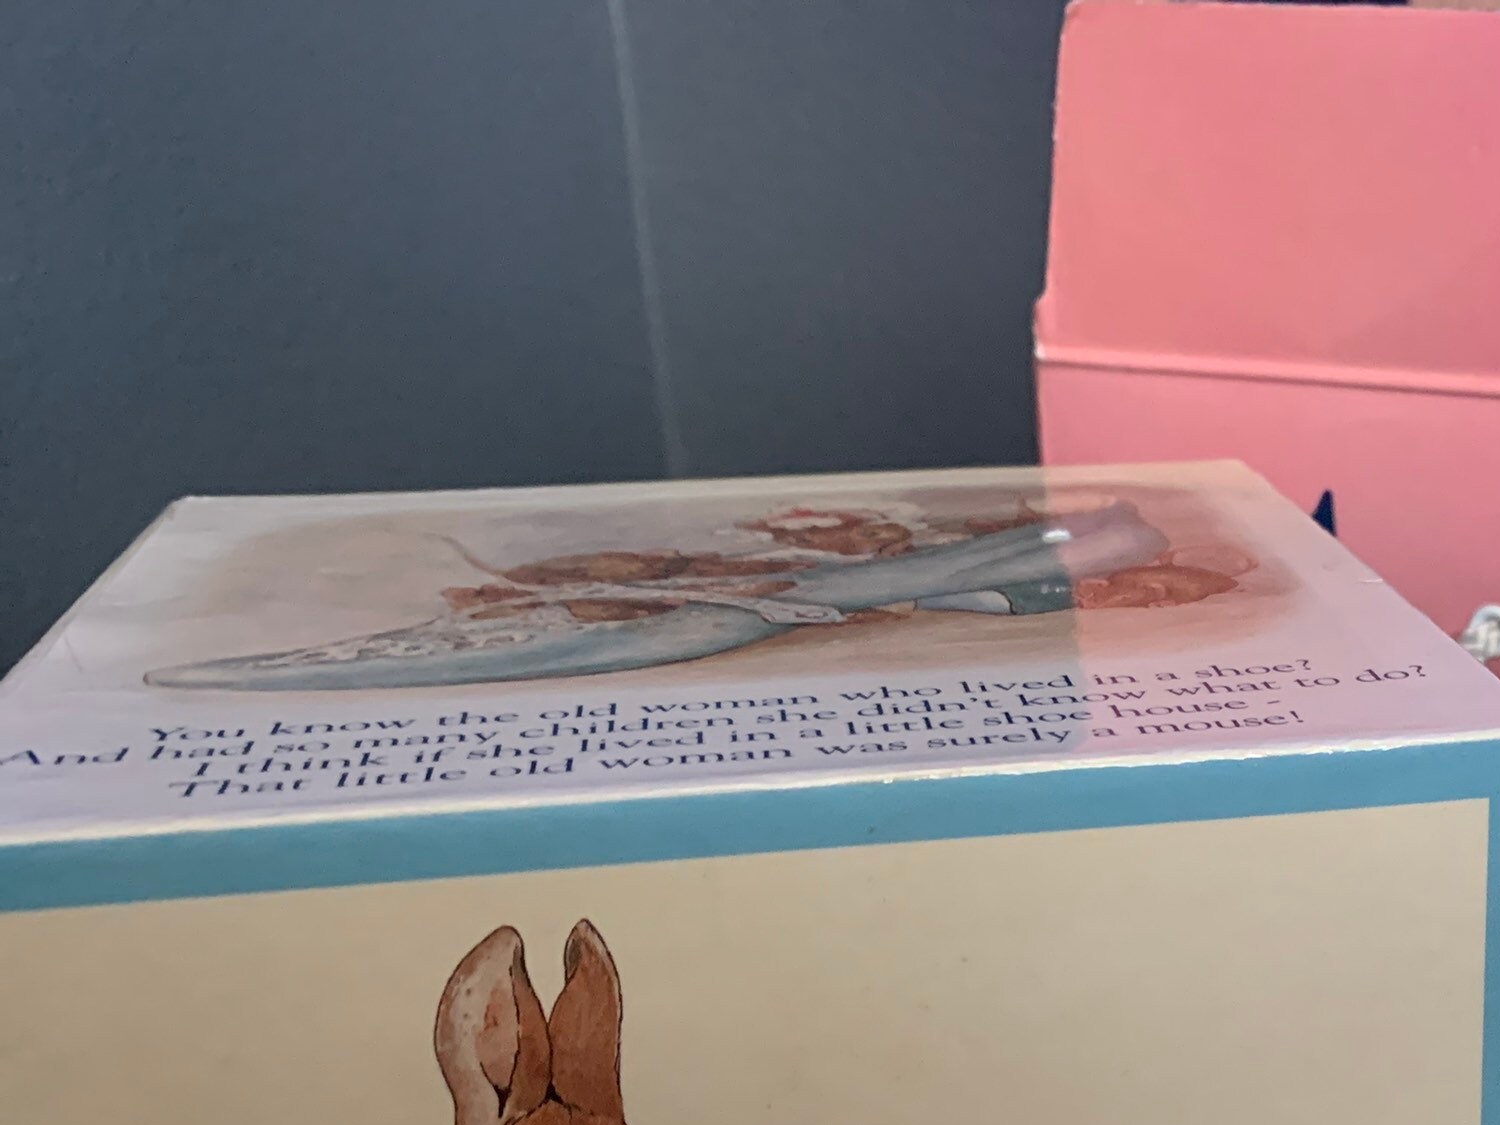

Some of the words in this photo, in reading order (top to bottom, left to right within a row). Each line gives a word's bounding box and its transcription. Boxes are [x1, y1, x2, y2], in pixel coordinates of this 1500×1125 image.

[0, 747, 129, 765] And
[150, 740, 254, 760] had
[273, 743, 330, 753] so
[353, 730, 502, 750] many
[519, 717, 735, 740] children
[757, 710, 839, 724] she
[857, 697, 1003, 717] didn't
[1019, 690, 1147, 708] know
[1166, 680, 1282, 698] what
[1294, 675, 1340, 688] to
[1355, 665, 1427, 684] do?
[150, 727, 244, 741] You
[269, 718, 416, 736] know
[439, 711, 519, 726] the
[540, 702, 616, 720] old
[641, 696, 819, 714] woman
[839, 685, 942, 701] who
[958, 675, 1076, 694] lived
[1092, 673, 1140, 686] in
[1155, 669, 1180, 682] a
[1195, 659, 1312, 680] shoe?
[196, 762, 208, 776] I
[238, 753, 389, 773] think
[414, 747, 456, 763] if
[467, 744, 555, 759] she
[580, 732, 704, 752] lived
[728, 730, 780, 744] in
[800, 728, 824, 739] a
[846, 717, 965, 735] little
[983, 710, 1094, 726] shoe
[1108, 699, 1250, 718] house
[168, 780, 312, 797] That
[337, 767, 467, 787] little
[489, 758, 574, 776] old
[599, 747, 793, 769] woman
[816, 741, 908, 755] was
[927, 727, 1071, 748] surely
[1092, 726, 1119, 737] a
[1136, 711, 1304, 735] mouse!
